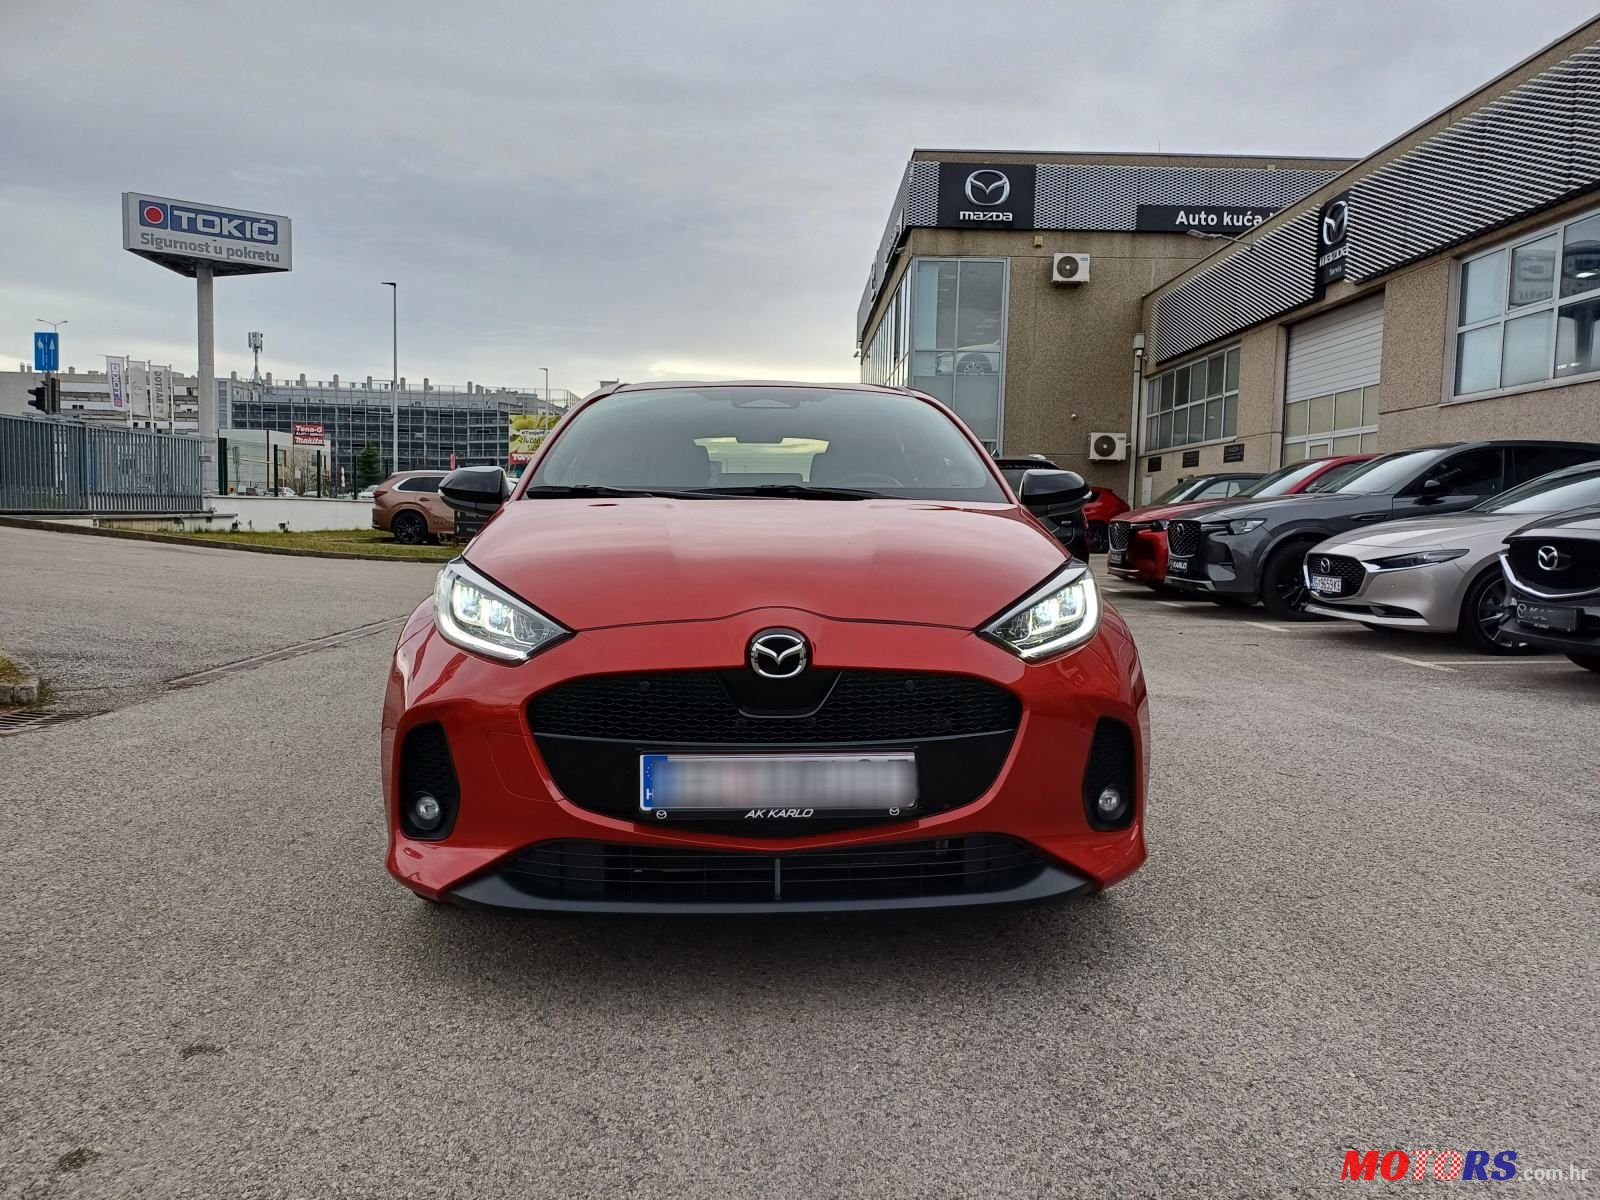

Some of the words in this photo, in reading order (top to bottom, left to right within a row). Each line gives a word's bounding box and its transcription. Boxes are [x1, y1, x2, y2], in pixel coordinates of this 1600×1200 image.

[959, 211, 1013, 222] mazda
[1175, 210, 1217, 225] Auto
[1223, 211, 1262, 226] kuća
[173, 209, 274, 242] TOKIĆ
[140, 232, 211, 253] Sigurnost
[214, 246, 222, 255] u
[226, 246, 280, 263] pokretu
[744, 809, 766, 818] AK
[767, 808, 814, 818] KARLO
